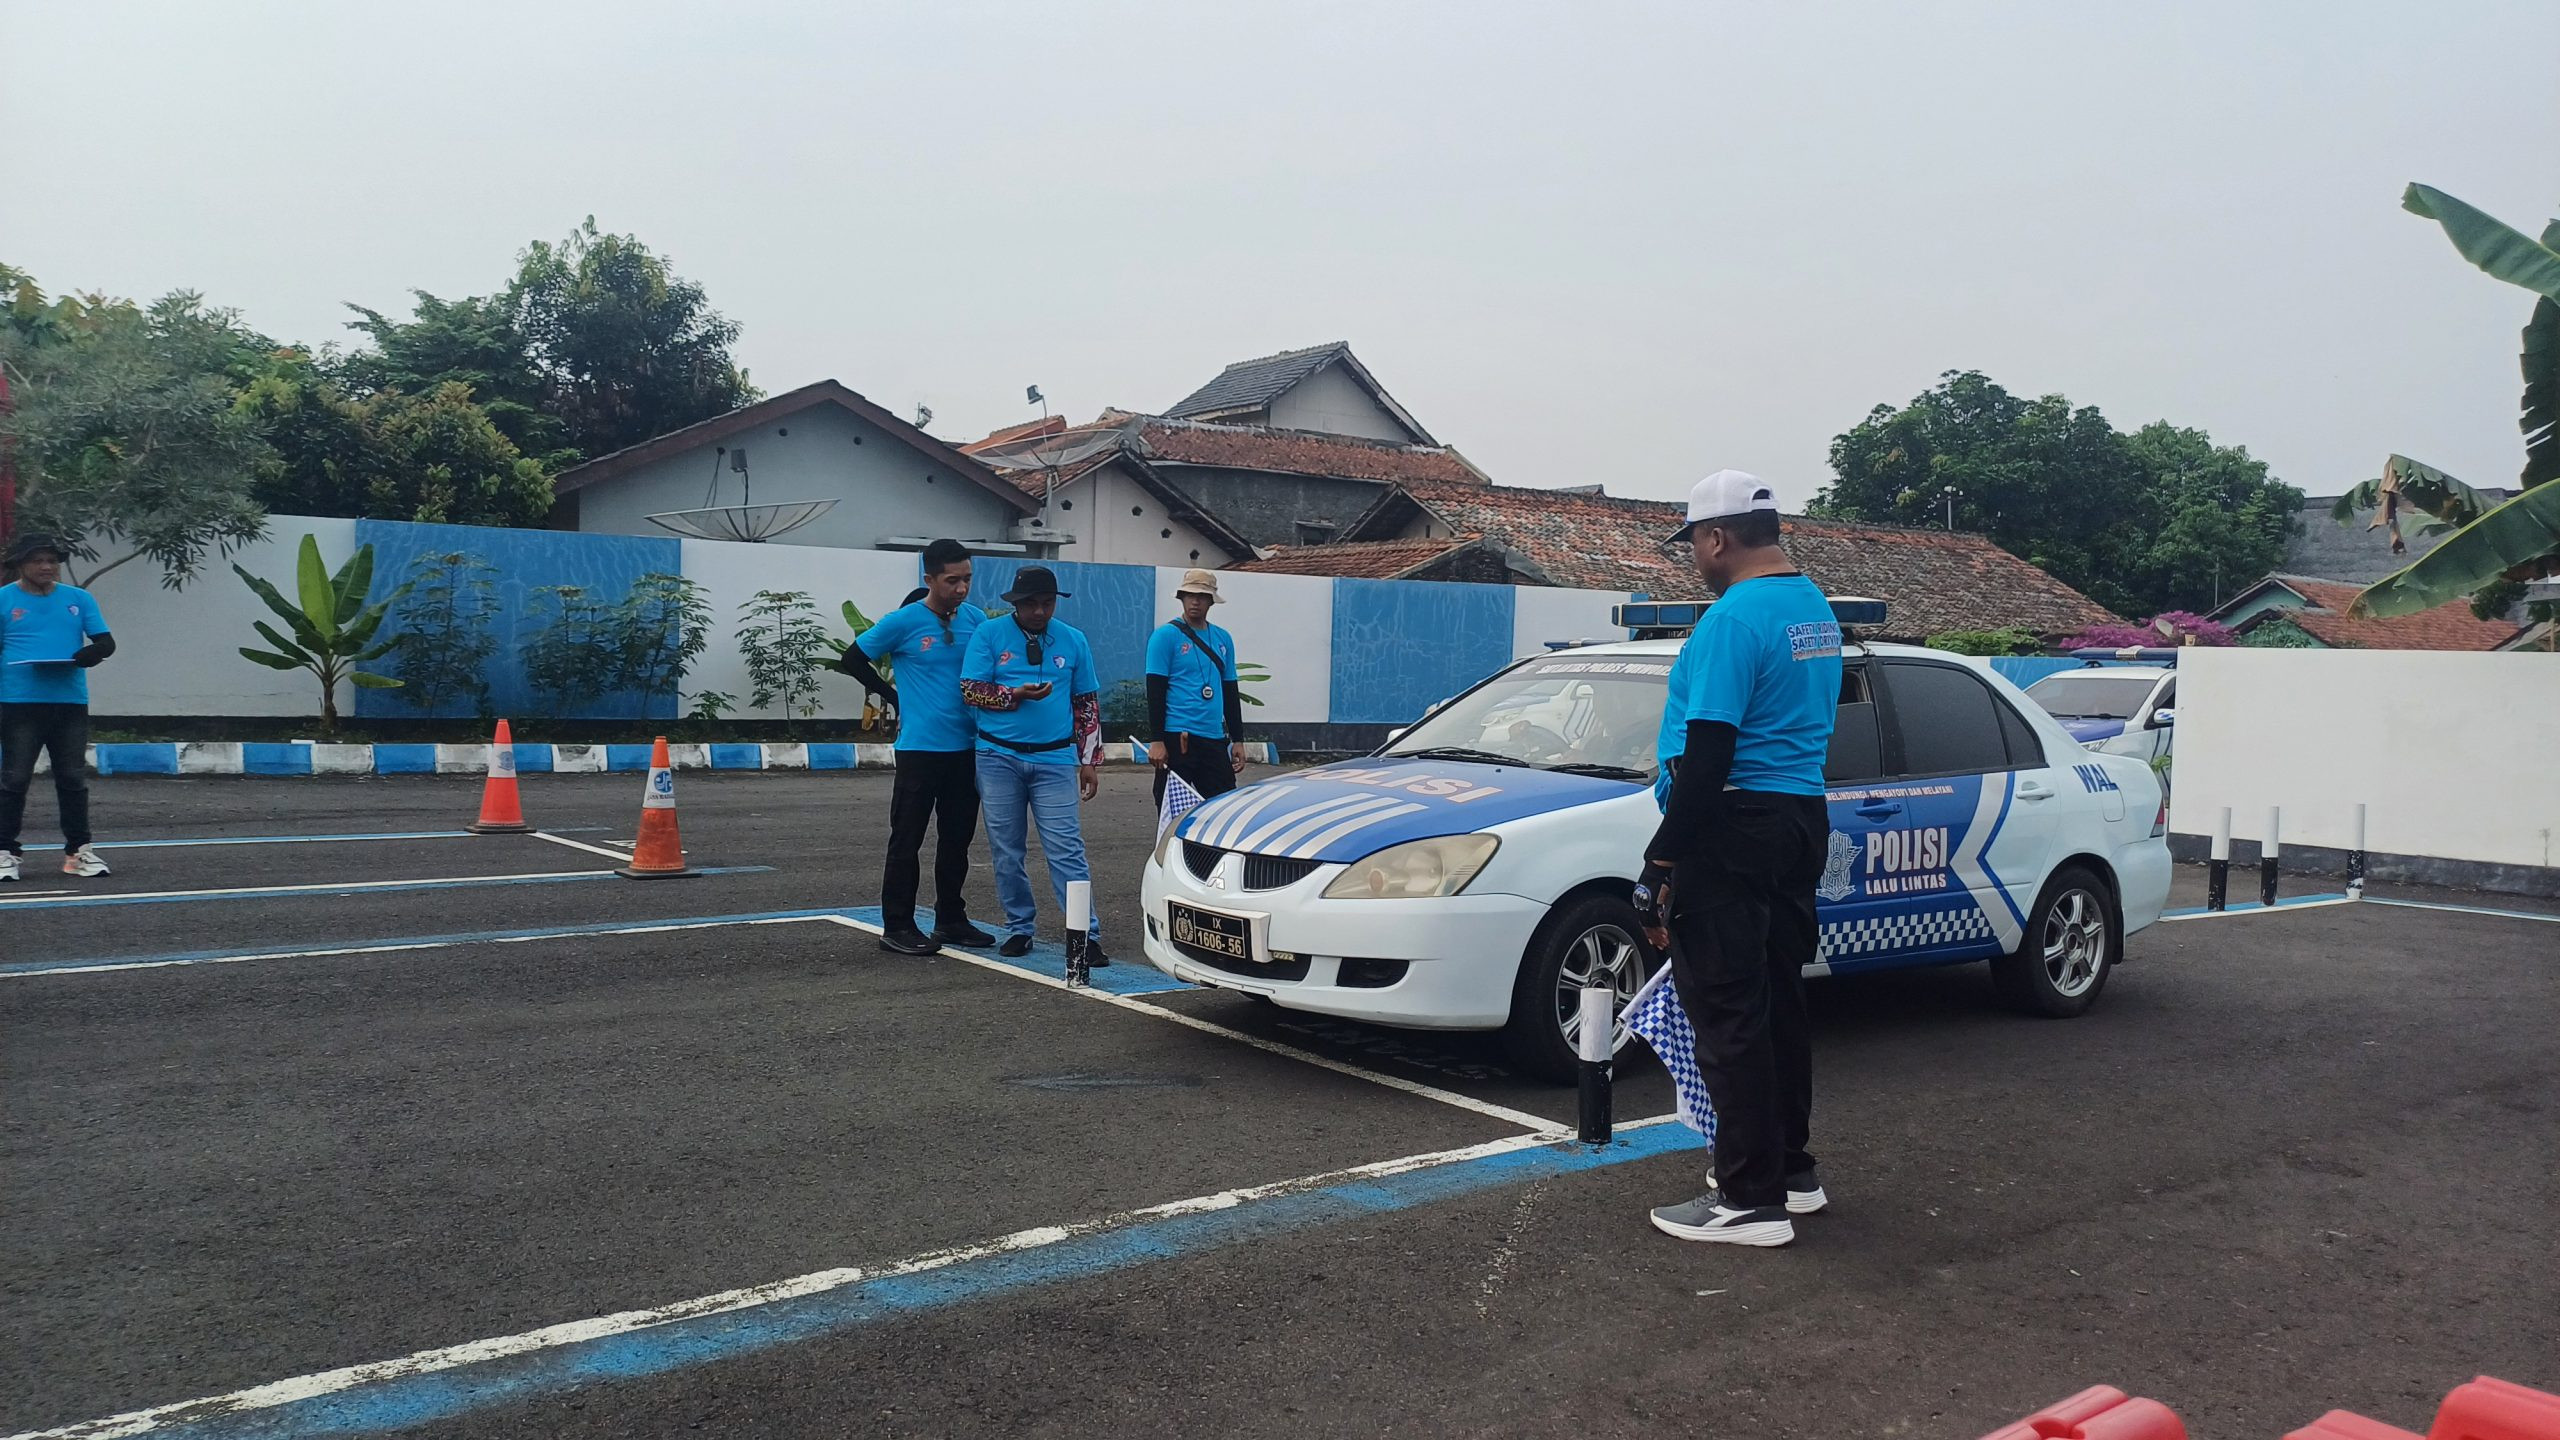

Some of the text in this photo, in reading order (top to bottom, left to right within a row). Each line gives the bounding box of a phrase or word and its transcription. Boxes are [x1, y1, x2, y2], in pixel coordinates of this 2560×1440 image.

[1787, 622, 1815, 638] SAFETY
[1792, 634, 1840, 650] SAFETY DRIVIN
[1290, 768, 1503, 803] POLISI
[2072, 763, 2119, 793] WAL
[1908, 787, 1922, 796] DAN
[1921, 785, 1954, 794] MELAYANI
[1866, 827, 1948, 874] POLISI
[1865, 873, 1947, 895] LALU LINTAS
[1212, 917, 1222, 930] IX
[1228, 937, 1242, 955] 56
